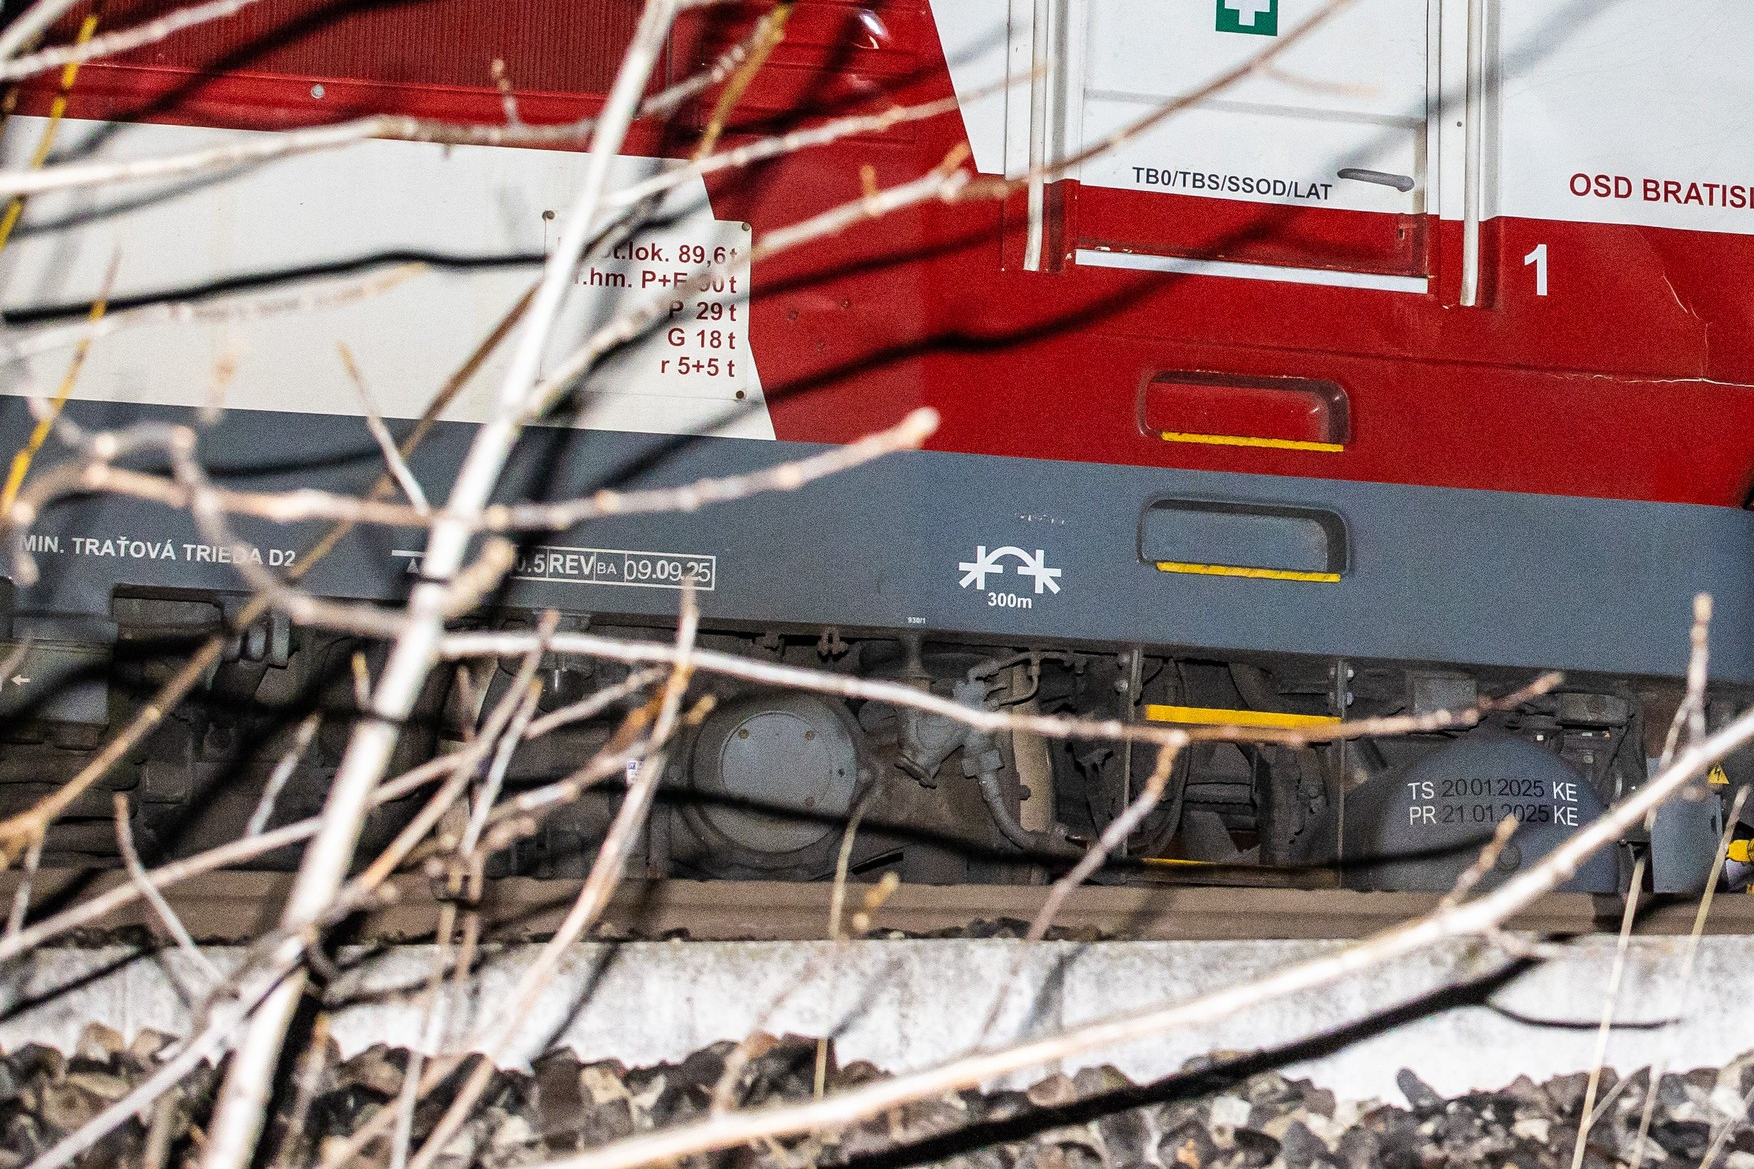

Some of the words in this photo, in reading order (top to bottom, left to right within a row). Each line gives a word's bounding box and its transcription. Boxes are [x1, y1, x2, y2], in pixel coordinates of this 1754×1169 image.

[1569, 173, 1633, 199] OSD
[678, 244, 726, 268] 89,6
[1523, 243, 1549, 297] 1
[729, 276, 737, 294] t
[669, 300, 684, 319] P
[696, 302, 723, 321] 29
[729, 304, 737, 322] t
[668, 328, 686, 347] G
[696, 329, 722, 349] 18
[728, 332, 736, 349] t
[661, 359, 670, 374] r
[677, 357, 720, 377] 5+5
[728, 360, 736, 377] t
[72, 536, 176, 561] TRAŤOVÁ
[183, 543, 263, 565] TRIEDA
[269, 549, 296, 567] D2
[549, 554, 595, 575] REV
[597, 562, 617, 575] BA
[625, 561, 711, 583] 09.09.25
[987, 591, 1032, 609] 300m
[1407, 781, 1435, 801] TS
[1552, 781, 1578, 803] KE
[1409, 805, 1437, 826] PR
[1553, 805, 1579, 827] KE
